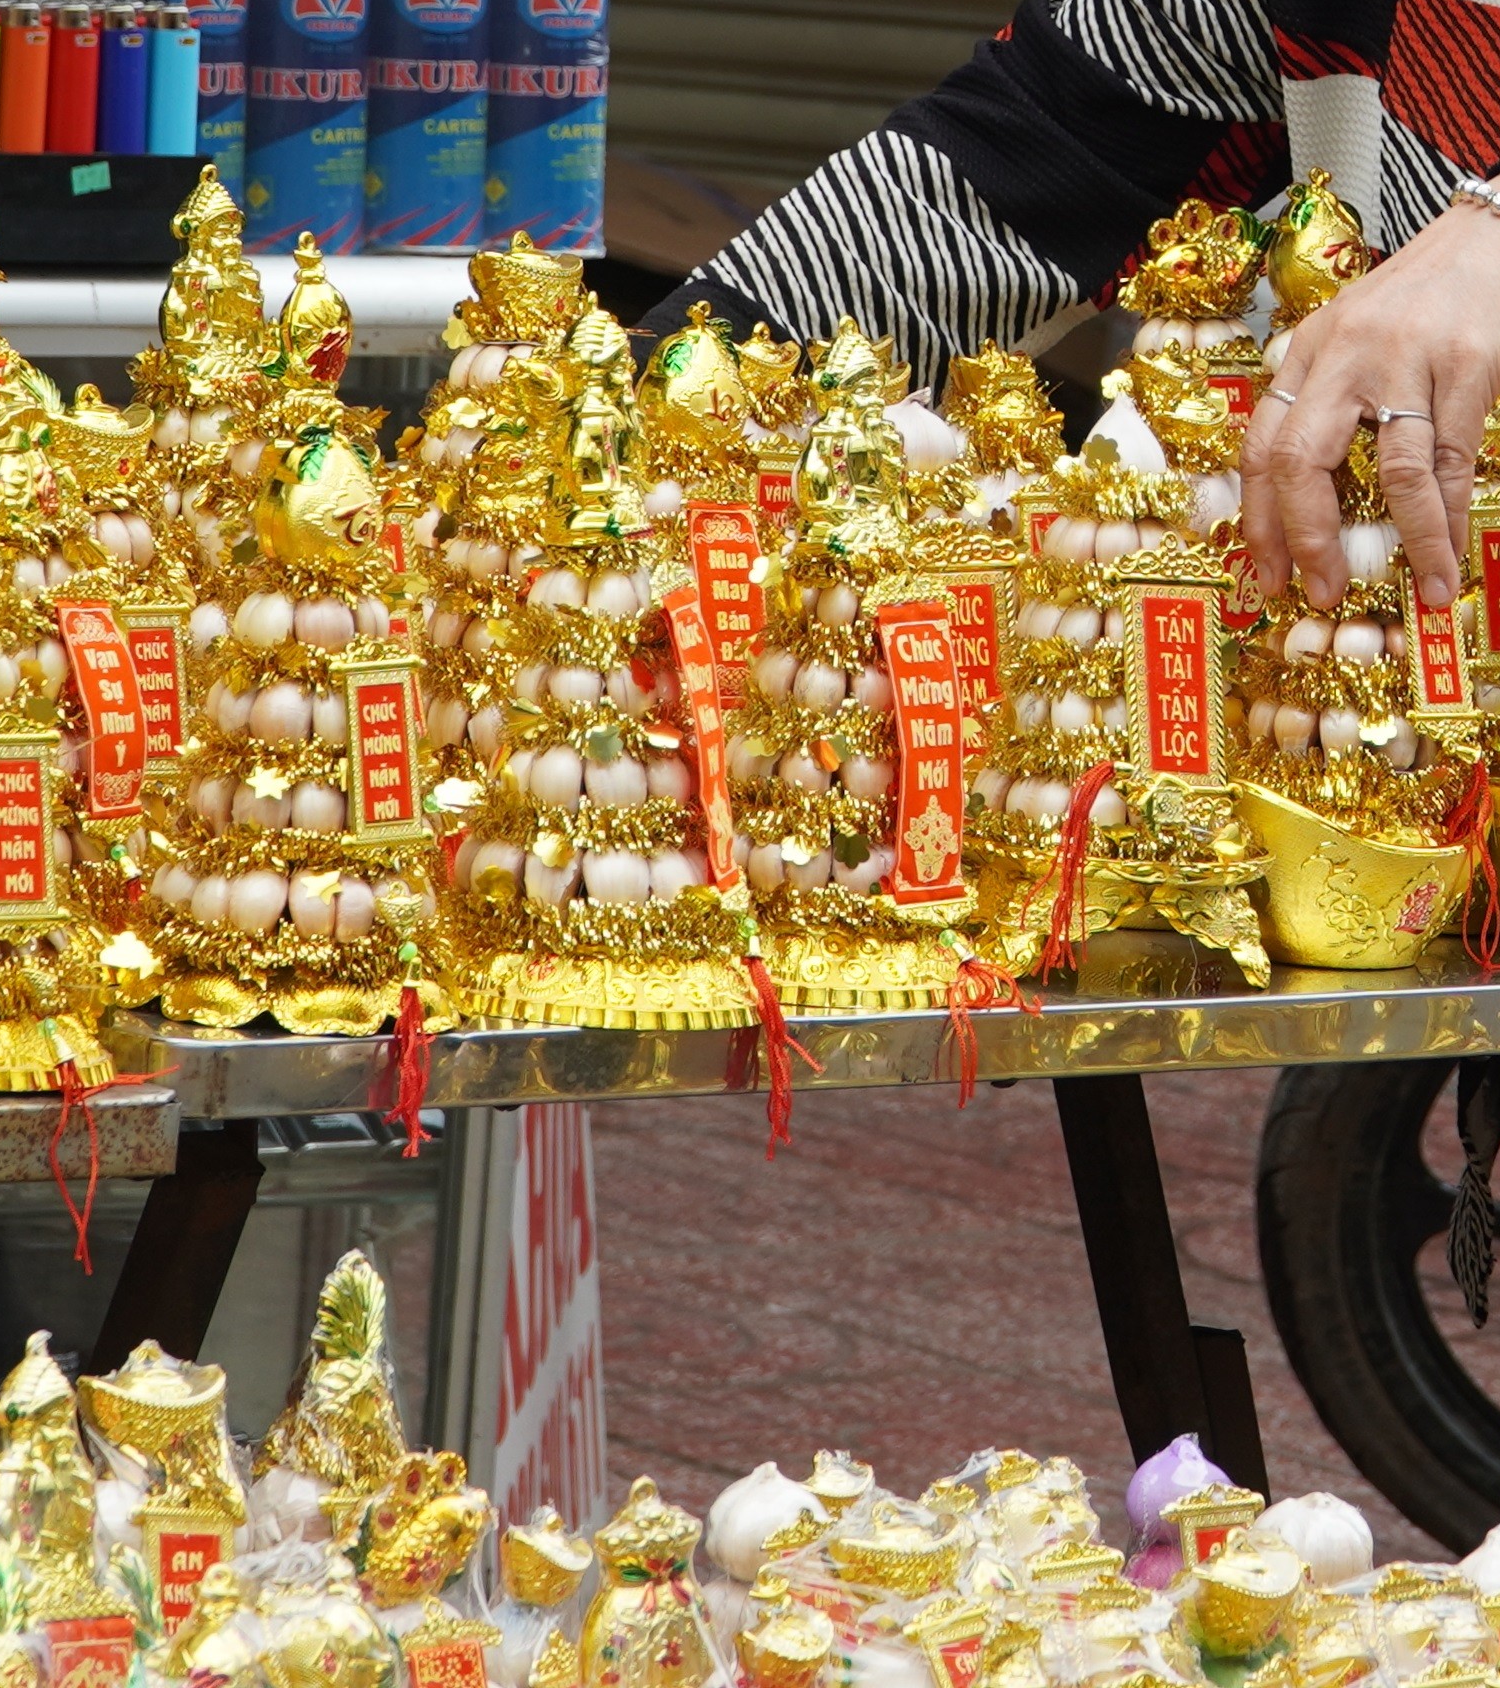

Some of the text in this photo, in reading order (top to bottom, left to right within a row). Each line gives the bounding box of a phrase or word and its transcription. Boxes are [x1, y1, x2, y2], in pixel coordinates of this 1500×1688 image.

[708, 549, 749, 570] Mua
[712, 579, 750, 603] May
[716, 608, 751, 632] Bán
[1155, 609, 1196, 644] TẤN
[1421, 606, 1452, 636] MỪNG
[134, 640, 169, 661] CHÚC
[896, 629, 945, 663] Chúc
[953, 632, 990, 666] ỪNG
[1427, 641, 1452, 665] NĂM
[84, 648, 120, 675] Vạn
[1160, 647, 1193, 681] TÀI
[101, 677, 124, 706] Sự
[900, 673, 955, 710] Mừng
[1433, 671, 1455, 696] MỚI
[362, 697, 397, 723] CHÚC
[1156, 679, 1199, 722] TẤN
[101, 709, 136, 734] Như
[911, 716, 954, 748] Năm
[146, 726, 172, 752] MỚI
[363, 730, 401, 756] MỪNG
[1159, 727, 1200, 765] LỘC
[114, 739, 125, 768] Ý
[369, 764, 401, 789] NĂM
[917, 757, 950, 791] Mới
[373, 794, 400, 821] MỚI
[0, 834, 37, 862] NĂM
[4, 865, 35, 894] MỚI
[170, 1551, 204, 1573] AN
[952, 1644, 982, 1674] CHÚ
